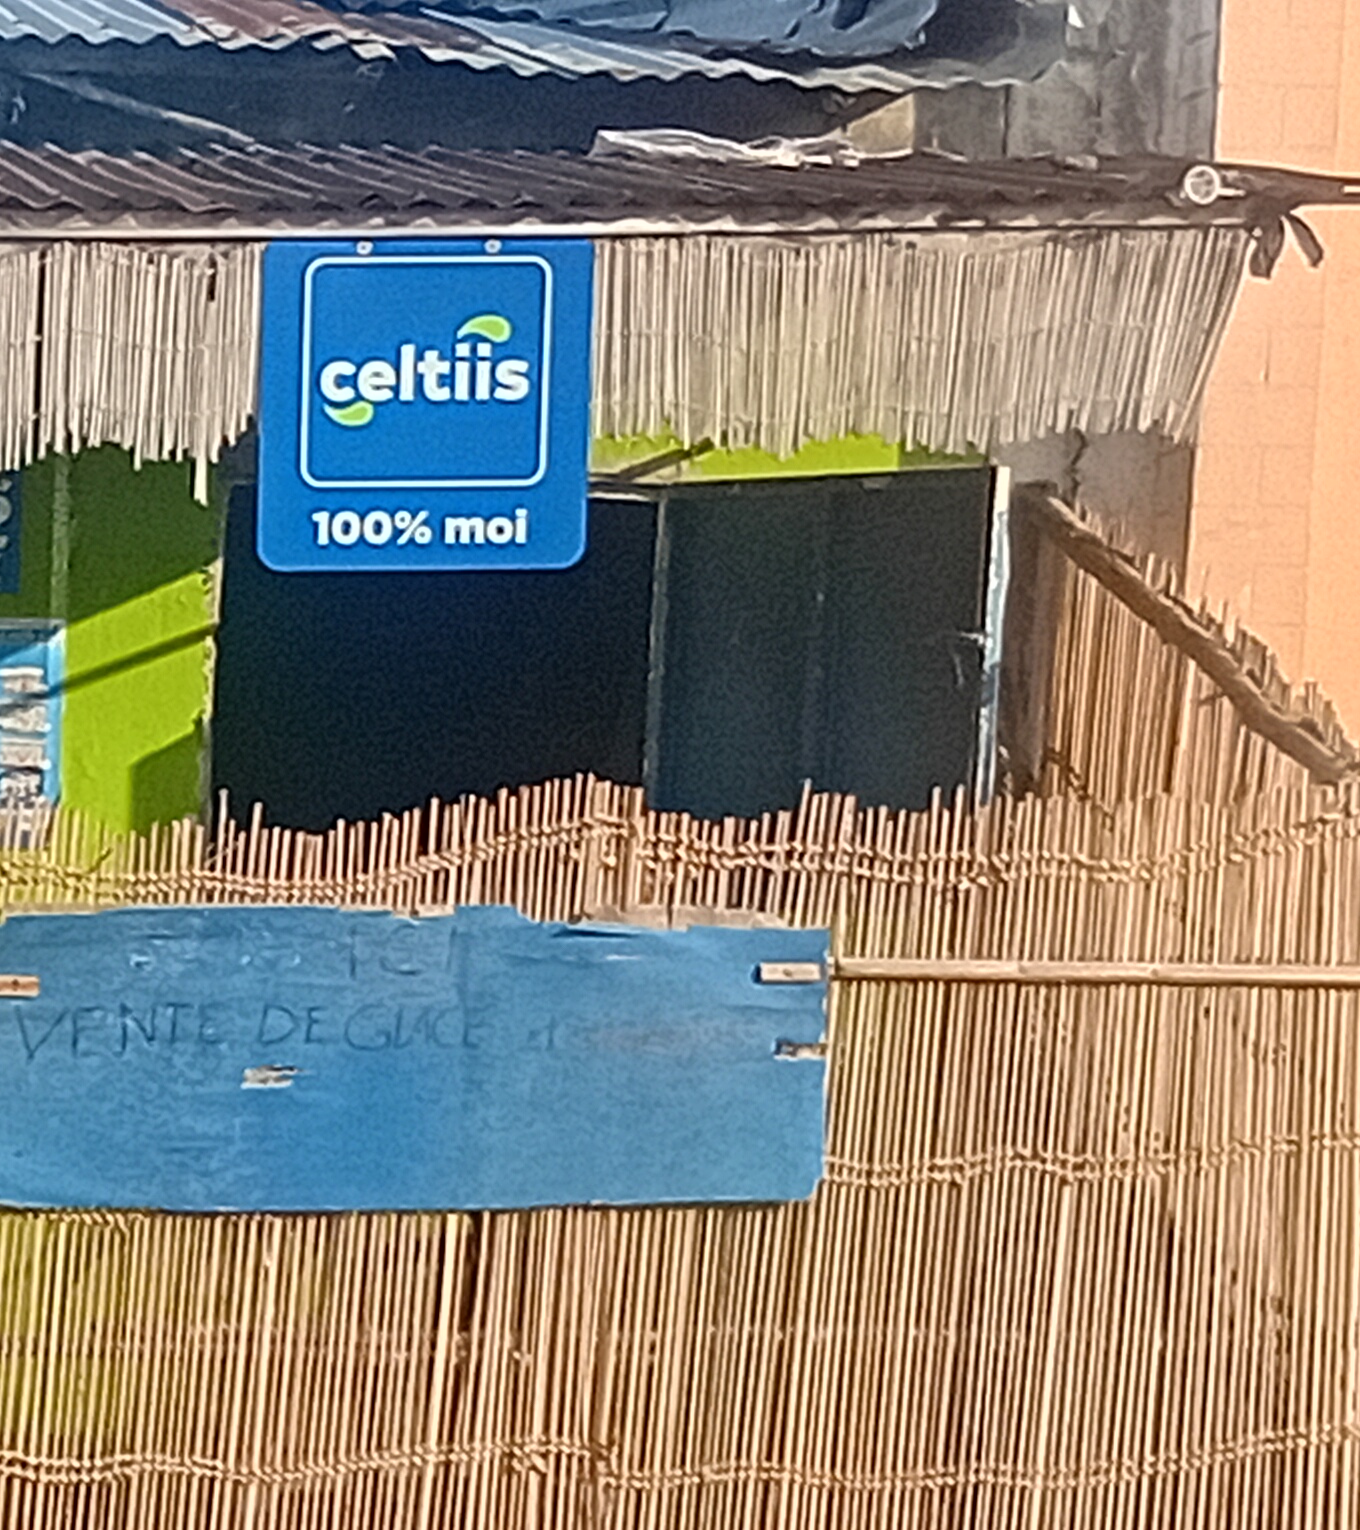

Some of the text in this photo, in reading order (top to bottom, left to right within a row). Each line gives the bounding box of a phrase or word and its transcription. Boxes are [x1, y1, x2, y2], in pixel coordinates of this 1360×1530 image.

[319, 342, 530, 402] celtiis
[312, 508, 528, 546] 100% moi
[13, 1001, 227, 1064] VENTE
[256, 1002, 326, 1047] DE
